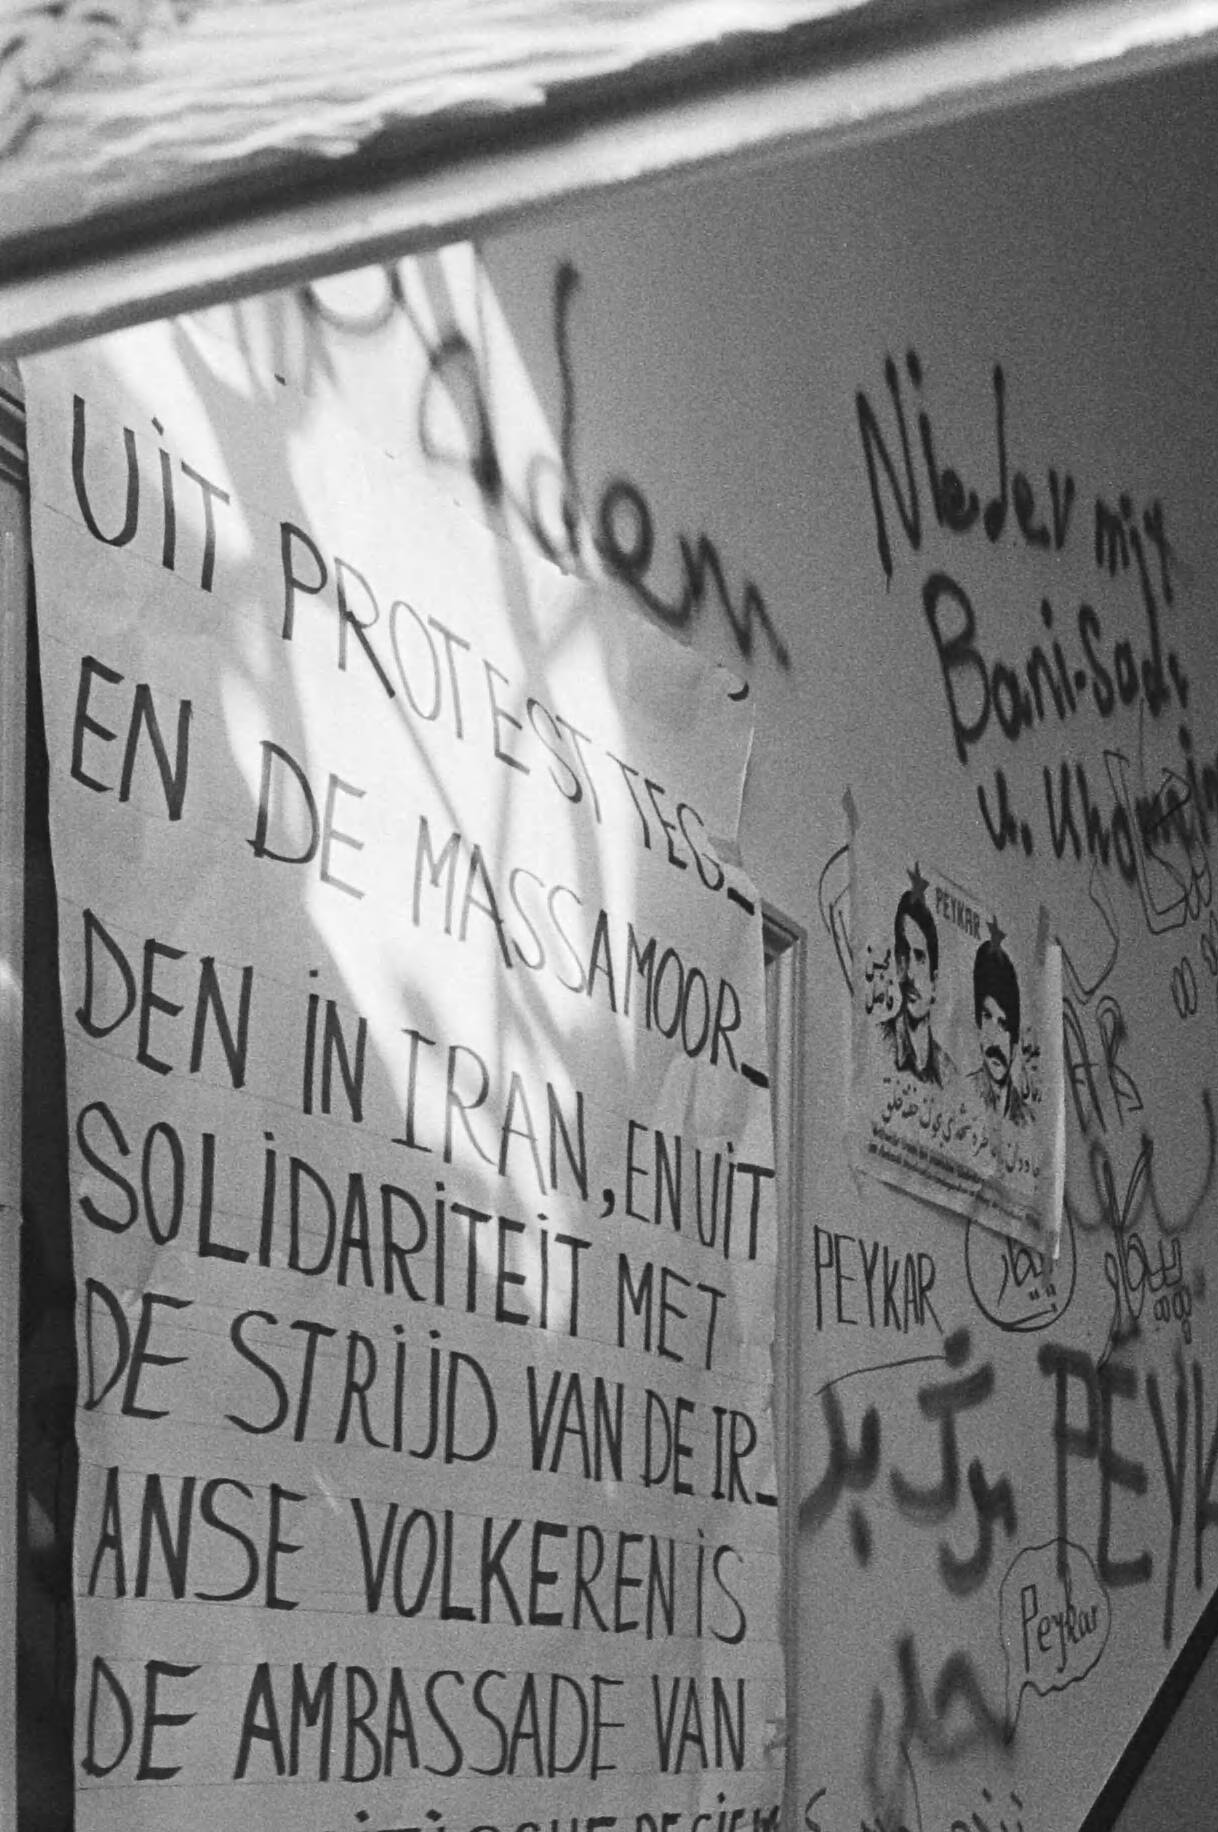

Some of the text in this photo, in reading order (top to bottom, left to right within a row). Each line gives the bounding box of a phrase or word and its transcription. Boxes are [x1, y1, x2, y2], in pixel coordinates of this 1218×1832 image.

[279, 522, 604, 823] PROTEST
[70, 655, 193, 821] EN
[246, 740, 367, 899] DE
[935, 887, 981, 940] PEYKAR
[75, 909, 254, 1088] DEN
[626, 1119, 683, 1231] EN
[616, 1252, 728, 1371] MET
[814, 1225, 944, 1335] PEYKAR
[83, 1277, 194, 1420] DE
[525, 1365, 626, 1482] VAN
[639, 1388, 695, 1497] DE
[86, 1466, 309, 1610] ANSE
[350, 1496, 676, 1641] VOLKEREN
[1020, 1584, 1099, 1674] Peykar
[81, 1656, 202, 1781] DE
[232, 1660, 628, 1784] AMBASSADE
[650, 1674, 748, 1777] VAN
